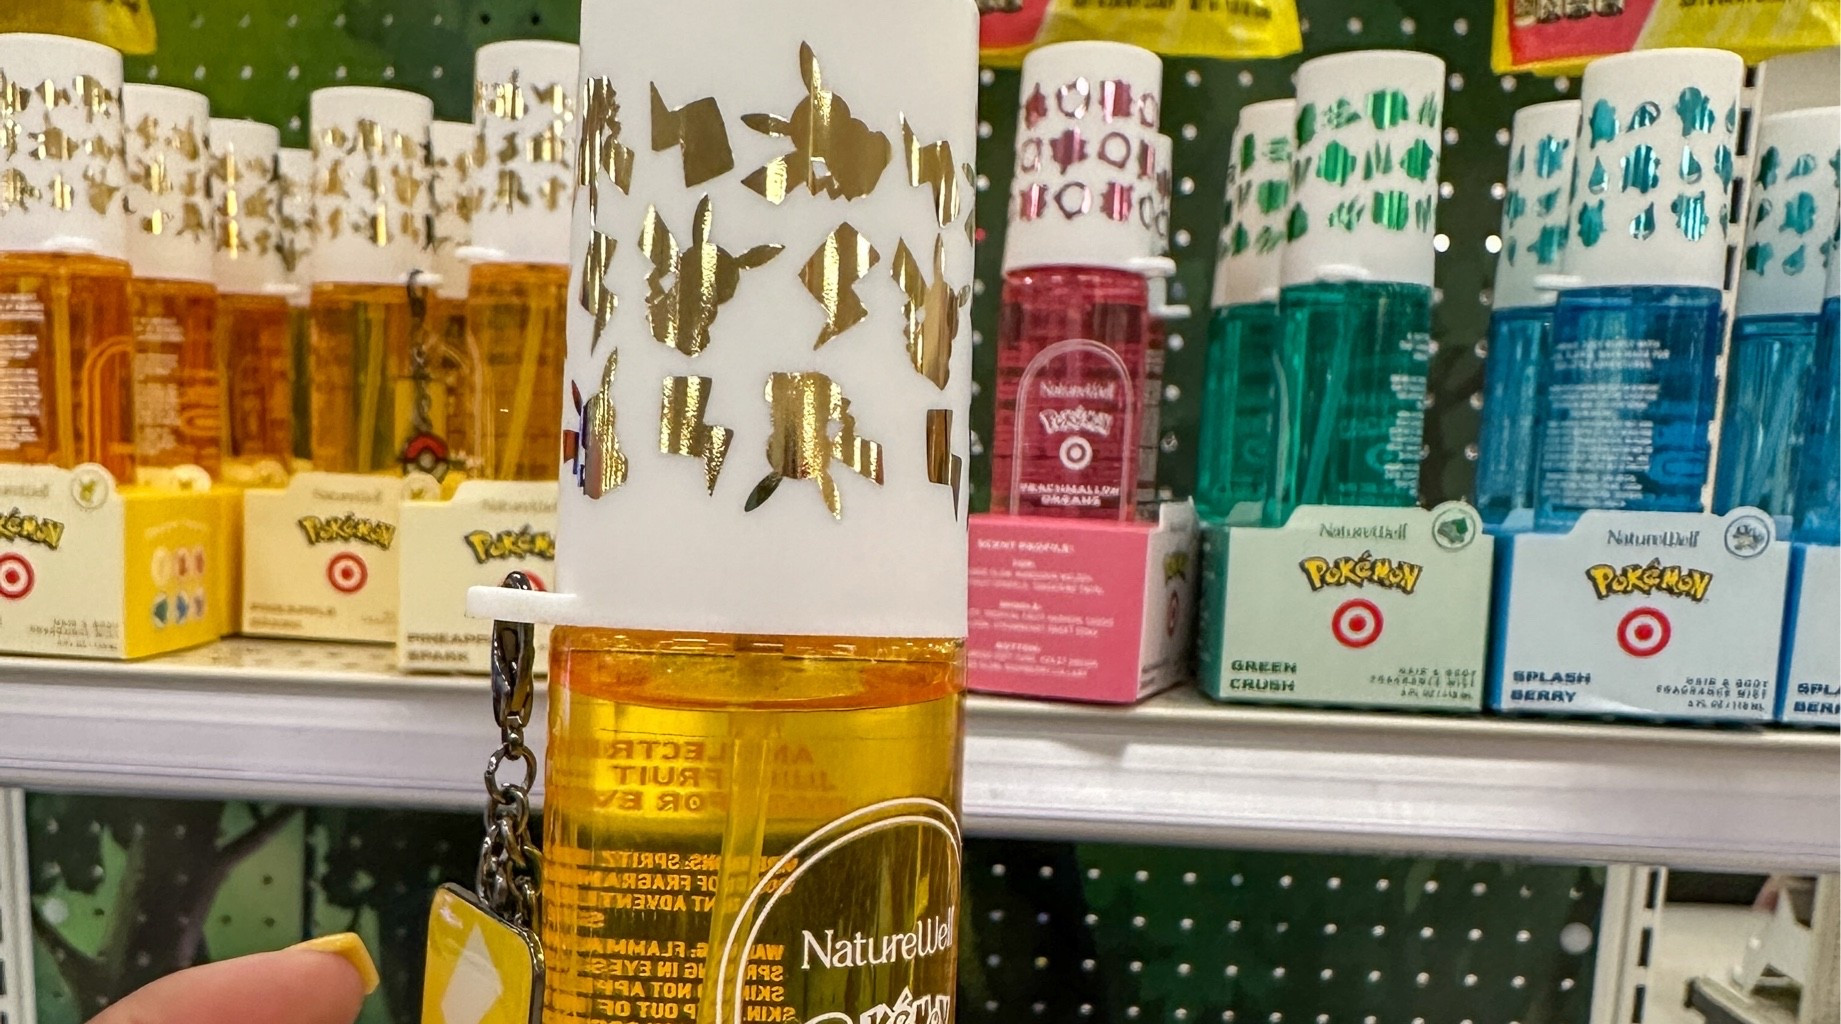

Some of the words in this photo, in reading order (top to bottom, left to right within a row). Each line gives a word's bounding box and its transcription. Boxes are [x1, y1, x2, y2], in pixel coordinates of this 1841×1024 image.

[1299, 549, 1423, 595] Pokémon
[1585, 557, 1714, 601] Pokémon
[407, 632, 492, 645] PINEAPP
[1231, 660, 1297, 674] GREEN
[1513, 670, 1591, 685] SPLASH
[1230, 678, 1295, 692] CRUSH
[1797, 682, 1840, 695] SPL
[1511, 690, 1577, 702] BERRY
[800, 906, 955, 970] NatureWell
